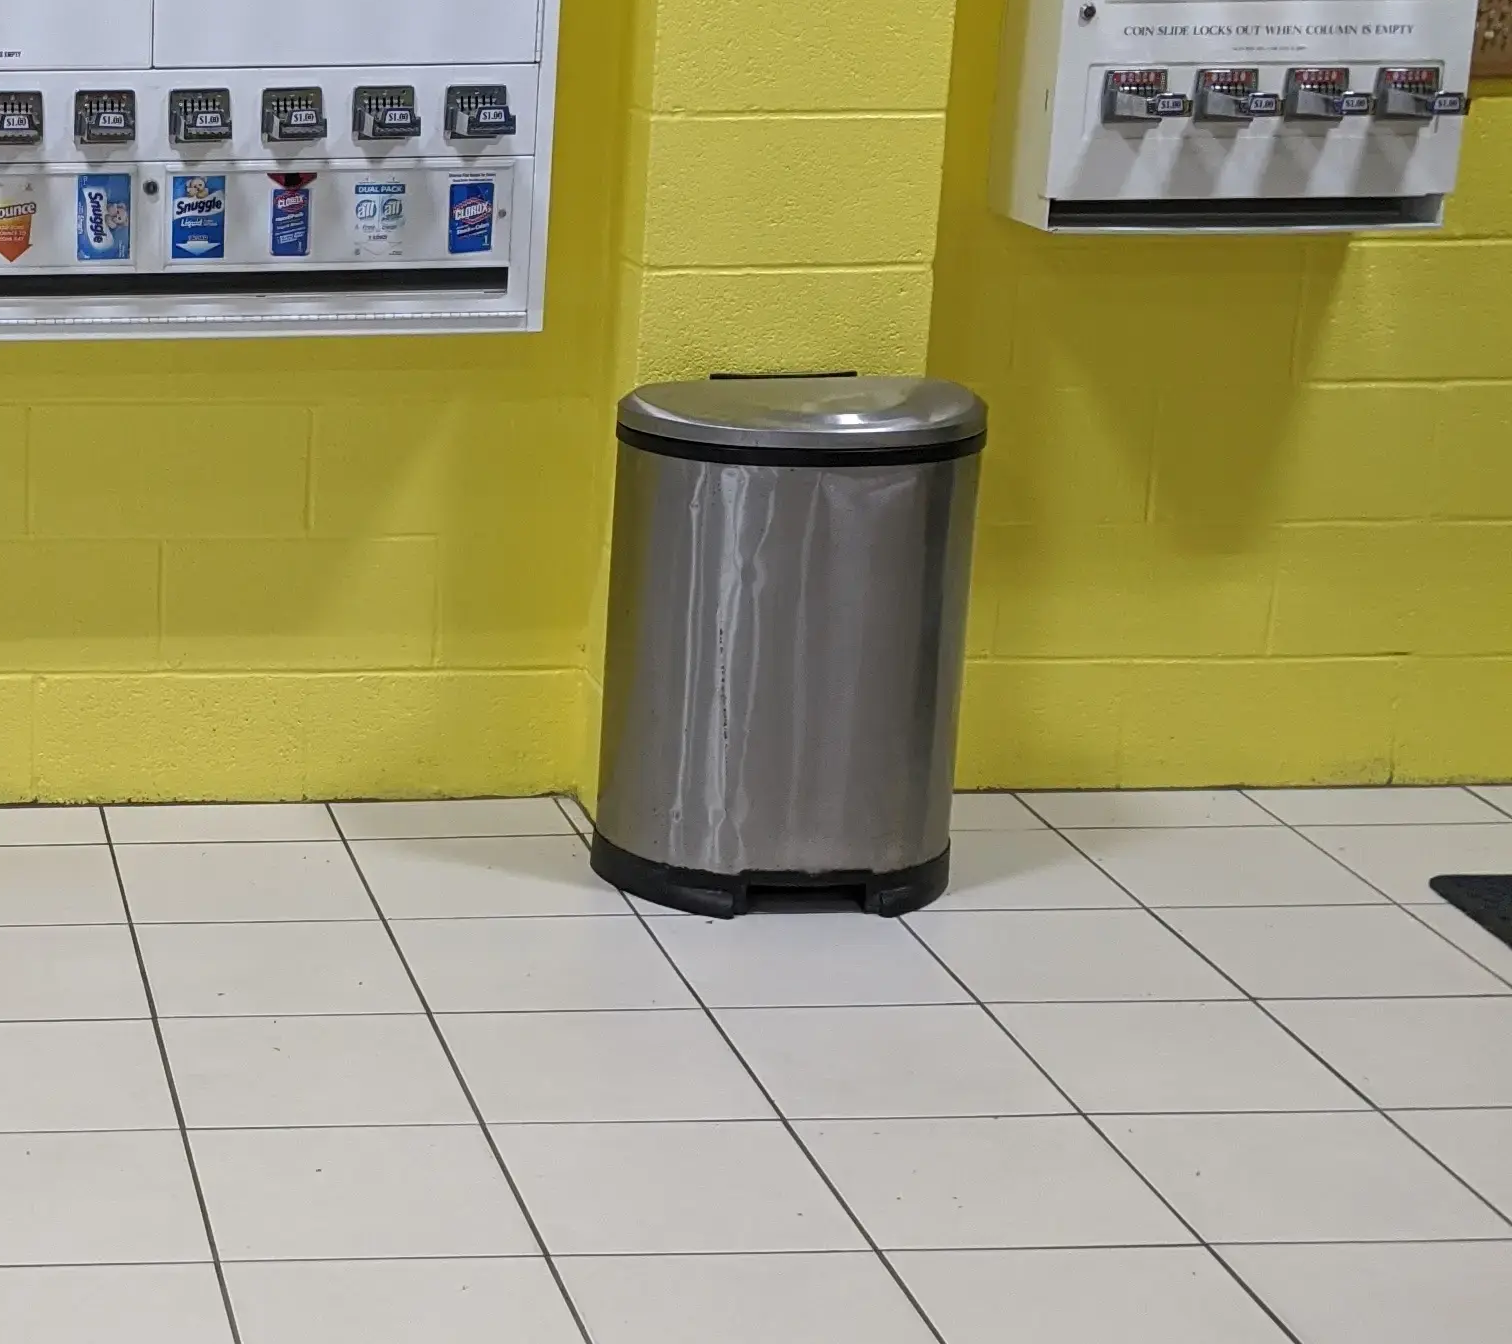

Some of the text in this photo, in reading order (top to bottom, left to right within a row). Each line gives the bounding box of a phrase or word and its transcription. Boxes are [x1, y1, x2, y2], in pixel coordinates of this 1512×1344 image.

[1124, 24, 1414, 36] COIN SLIDE LOCKS OUT WHEN COLUMN IS EMPTY
[101, 114, 122, 124] $1.00
[199, 114, 219, 124] $1.00
[293, 112, 314, 122] $1.00
[388, 111, 409, 121] $1.00
[482, 111, 503, 120] $1.00
[6, 116, 26, 126] $1.00
[381, 185, 404, 193] PACK
[176, 197, 222, 215] Snuggle
[356, 199, 375, 219] all
[383, 199, 402, 217] all
[455, 202, 490, 220] CLOROX
[88, 192, 103, 244] Snuggle
[181, 218, 203, 228] Liquid
